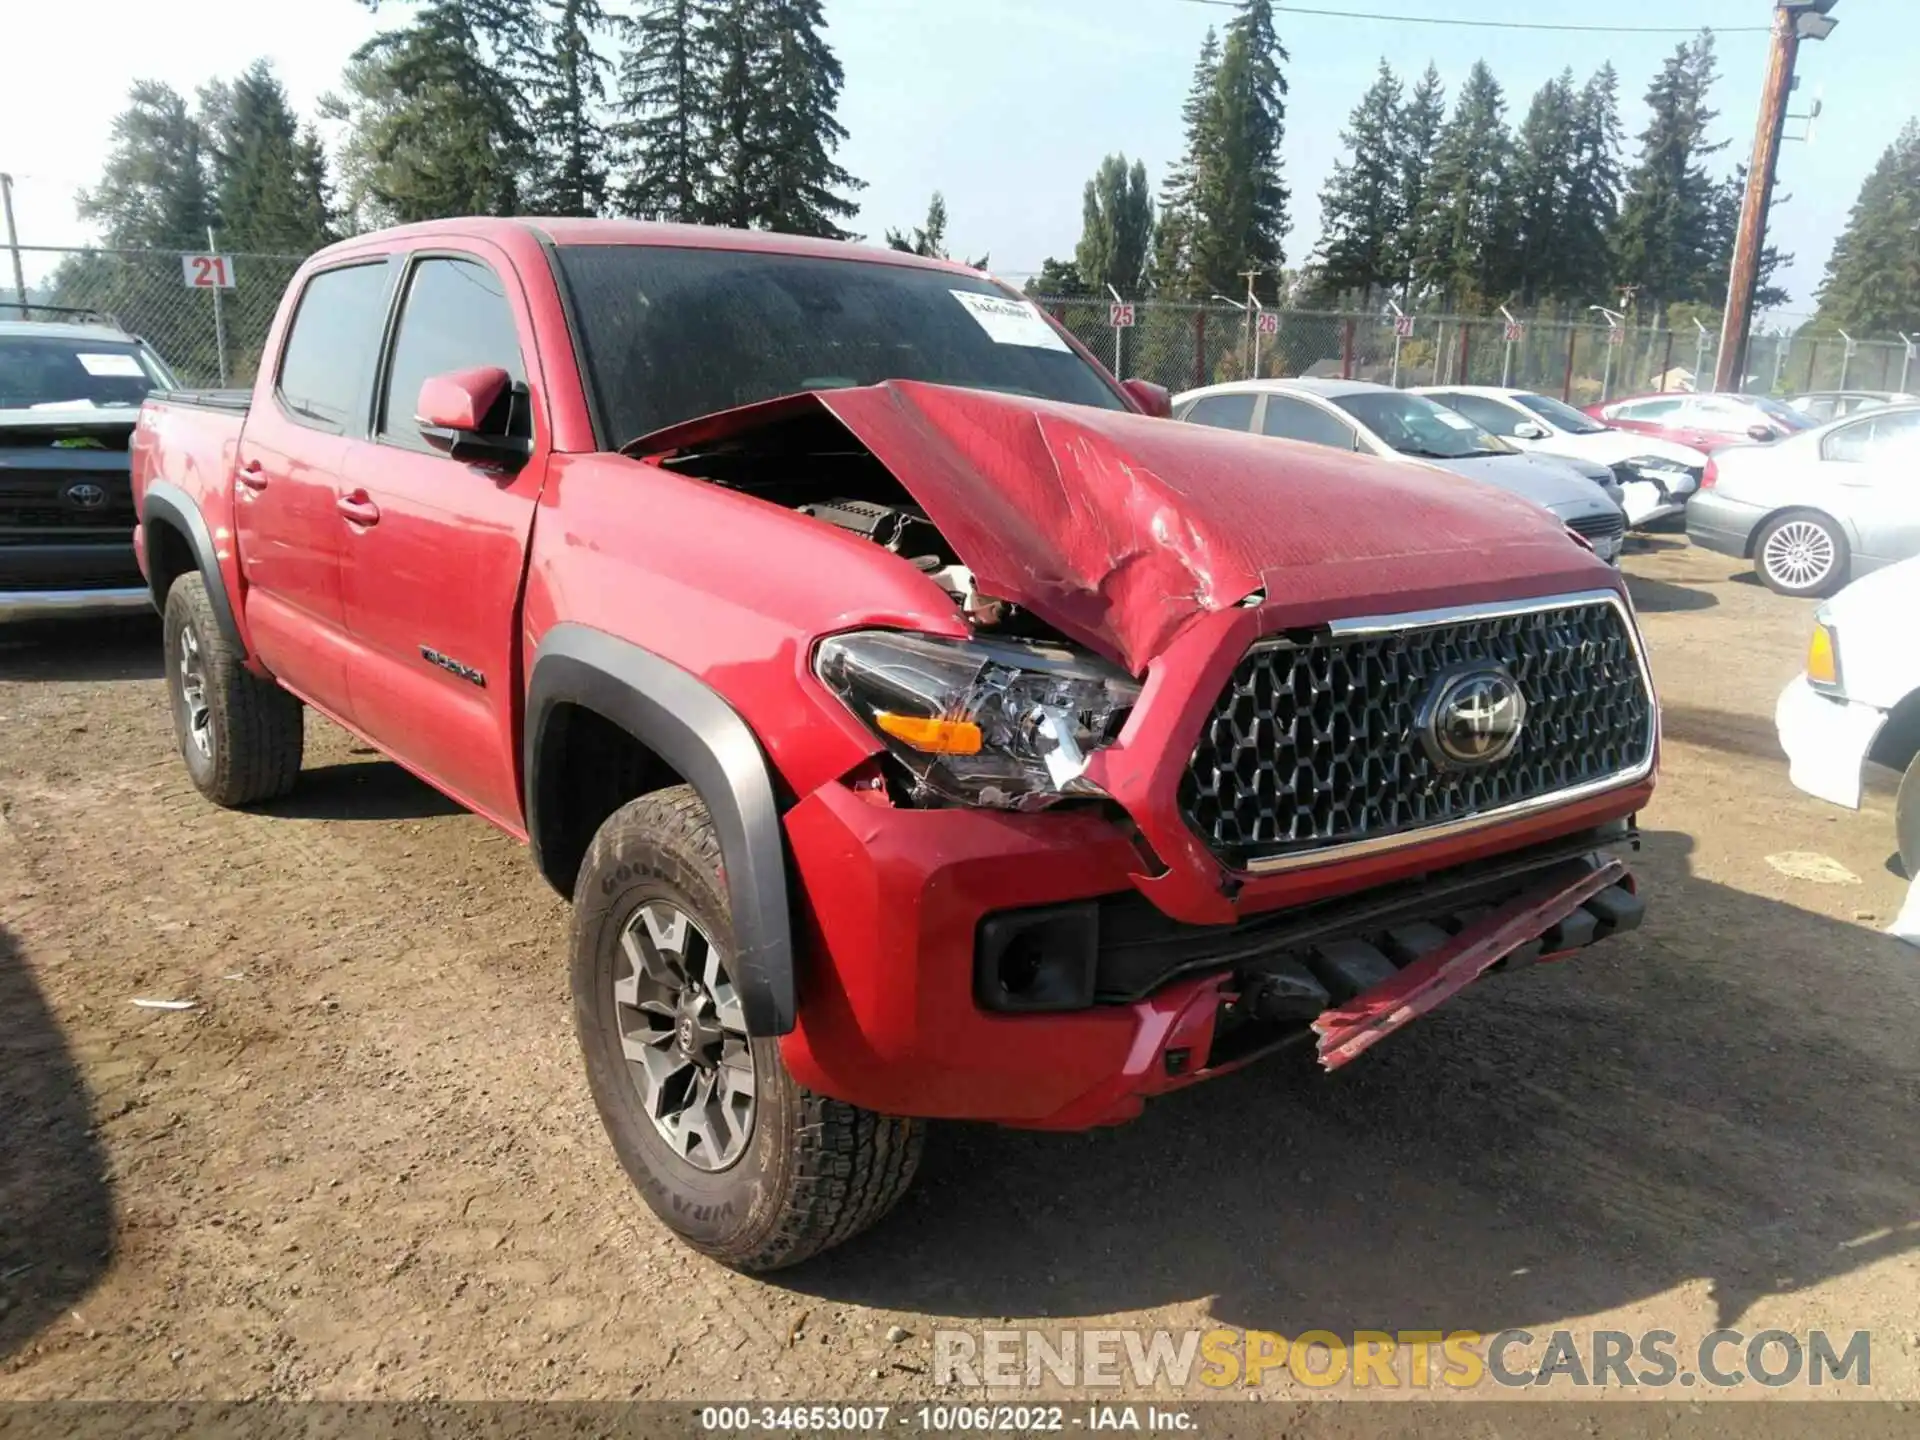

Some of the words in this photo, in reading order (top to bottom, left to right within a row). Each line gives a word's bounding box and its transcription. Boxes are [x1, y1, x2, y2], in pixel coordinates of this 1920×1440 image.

[192, 256, 226, 286] 21
[1112, 306, 1133, 326] 25
[1258, 314, 1276, 333] 26
[1395, 318, 1411, 336] 27
